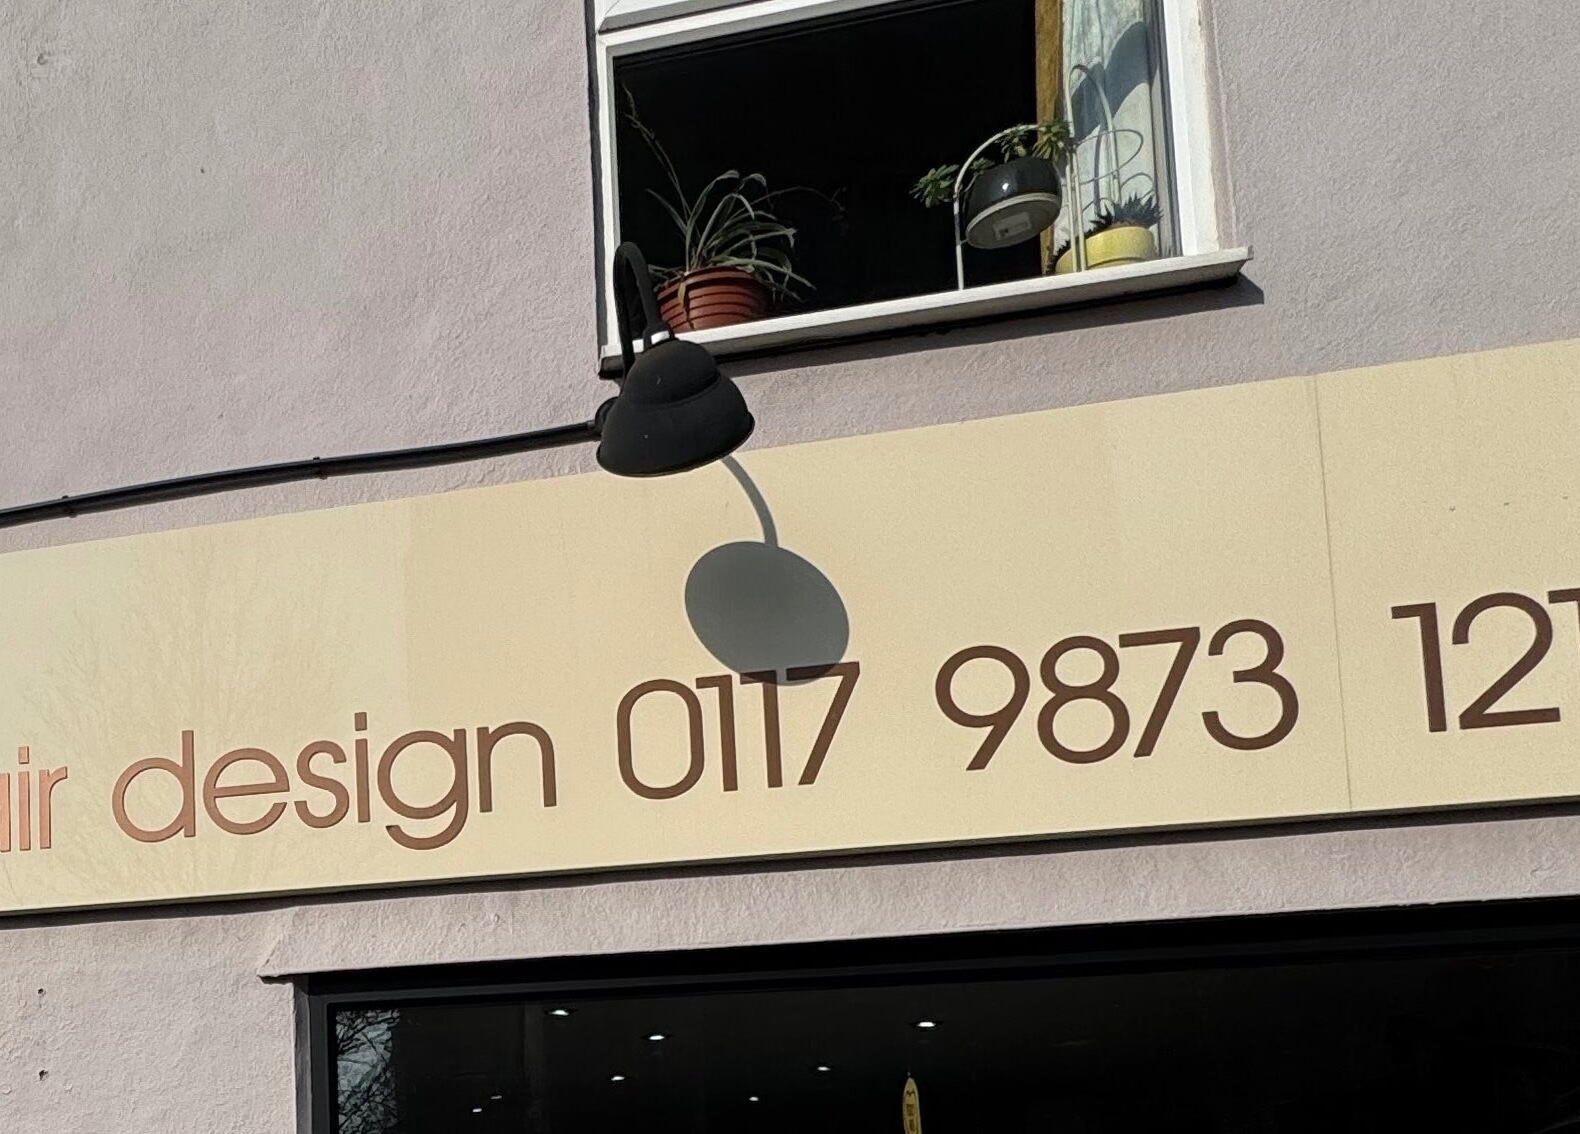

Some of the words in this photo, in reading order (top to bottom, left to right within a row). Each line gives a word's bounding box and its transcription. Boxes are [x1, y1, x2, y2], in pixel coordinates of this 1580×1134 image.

[111, 711, 559, 850] design
[616, 661, 861, 799] 0117
[934, 618, 1300, 771] 9873
